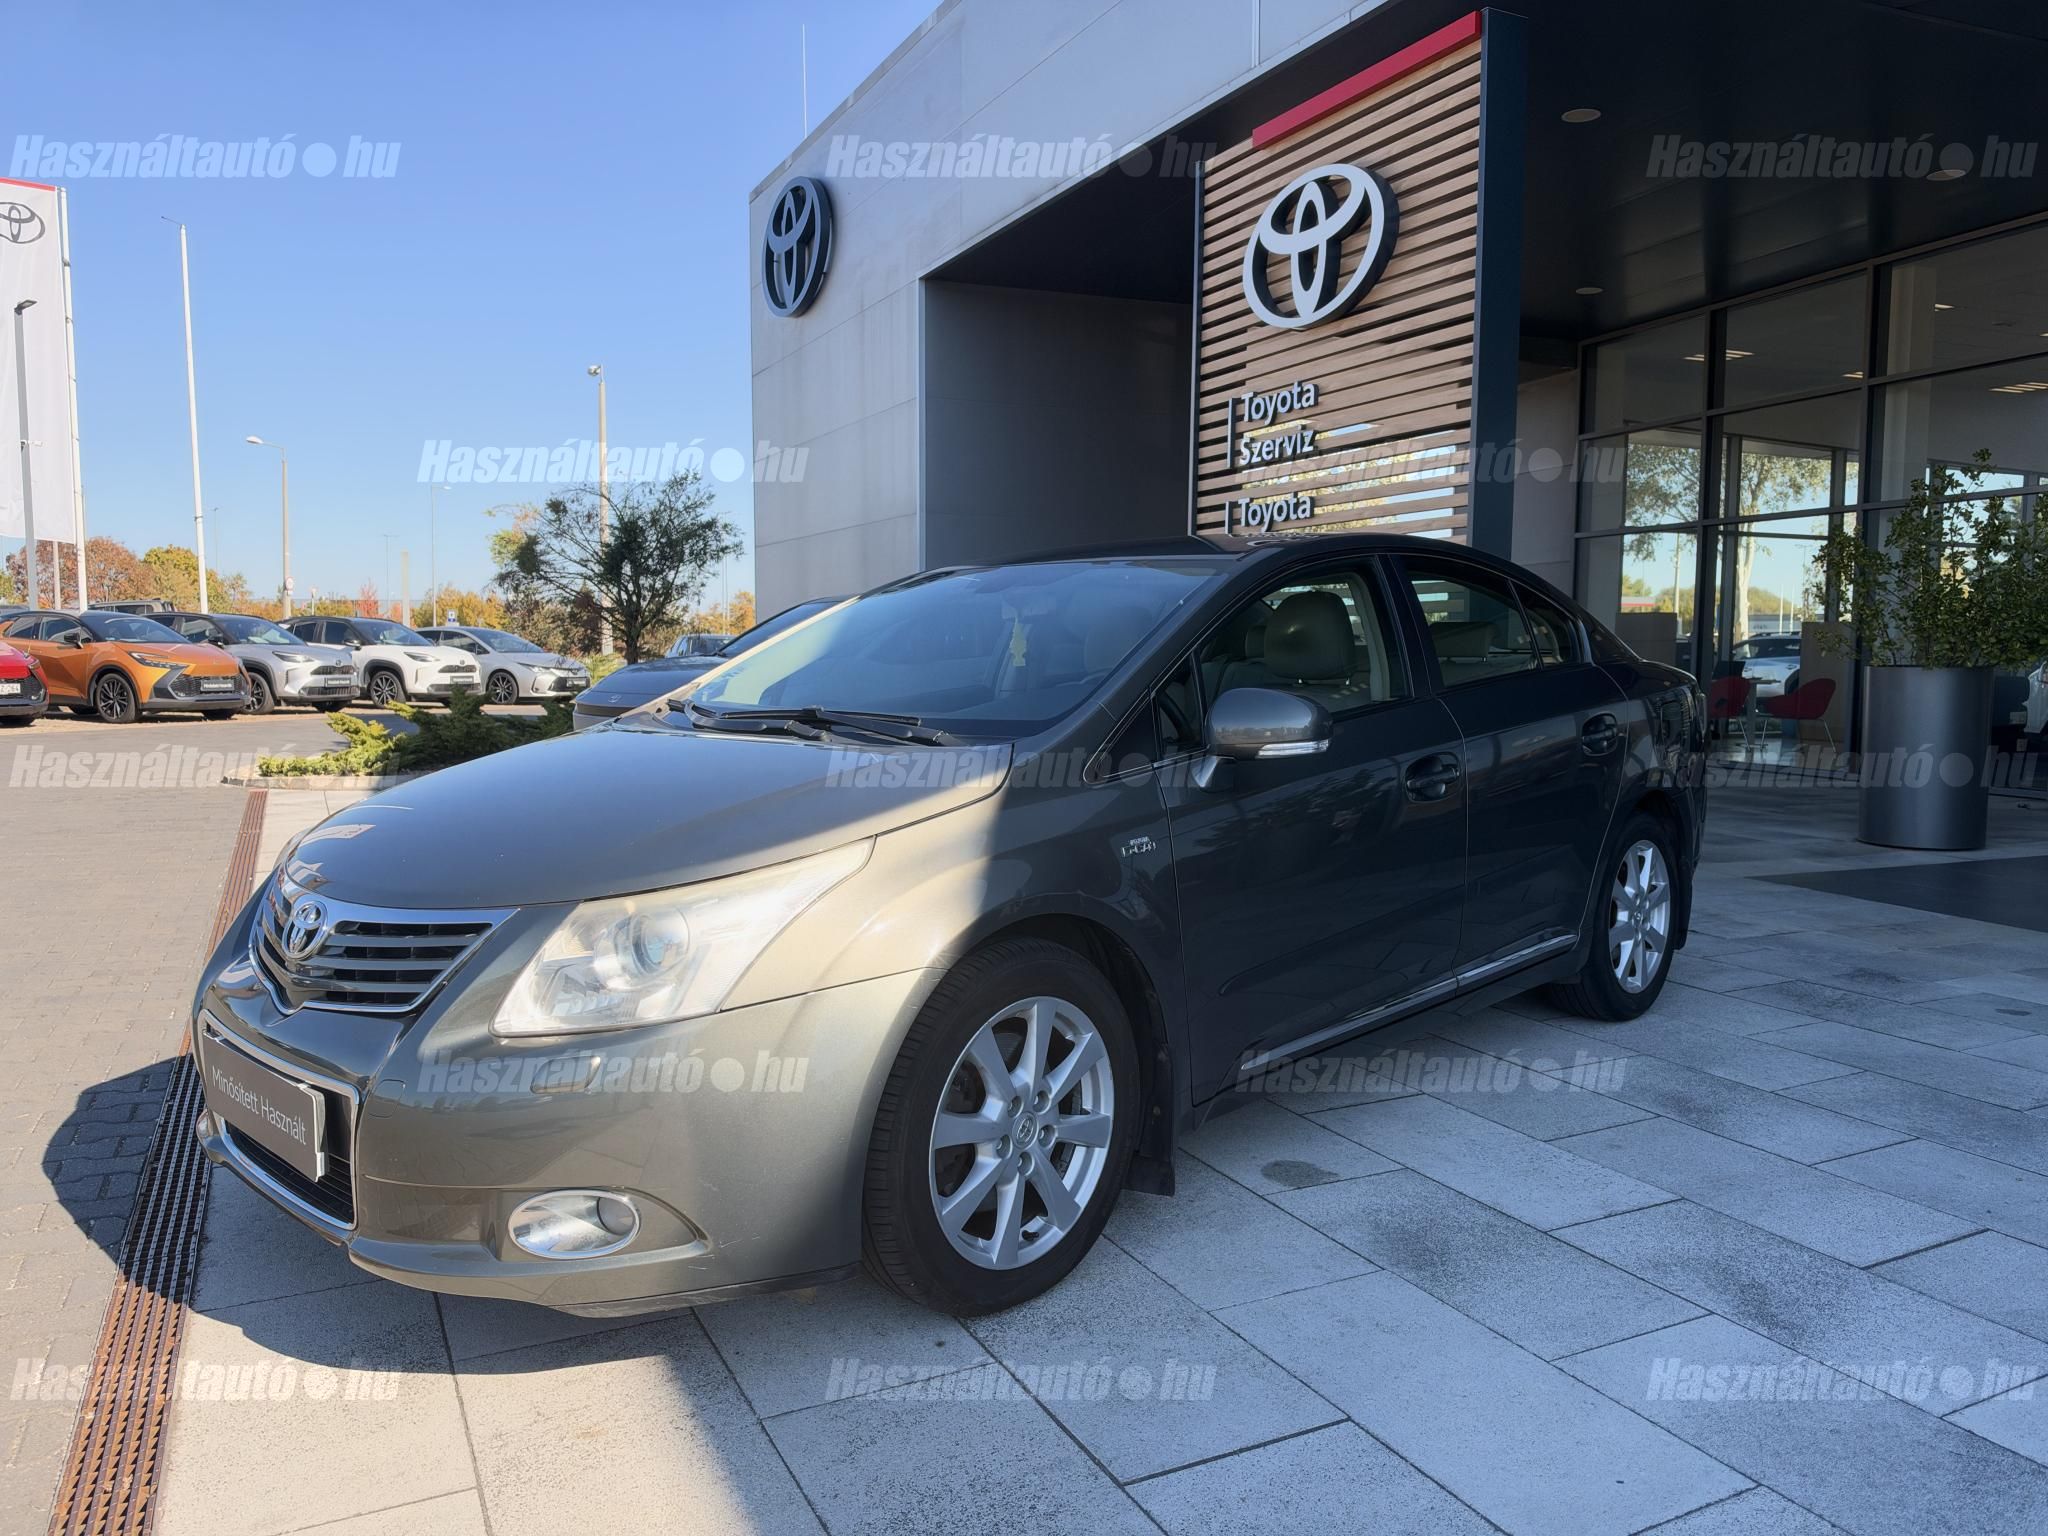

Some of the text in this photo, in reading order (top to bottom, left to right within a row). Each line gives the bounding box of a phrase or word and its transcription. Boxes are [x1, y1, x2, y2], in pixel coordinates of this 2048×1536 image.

[1240, 381, 1318, 425] Toyota
[1239, 424, 1316, 466] Szerviz
[1237, 492, 1313, 533] Toyota
[212, 1065, 307, 1146] Minősített Használt
